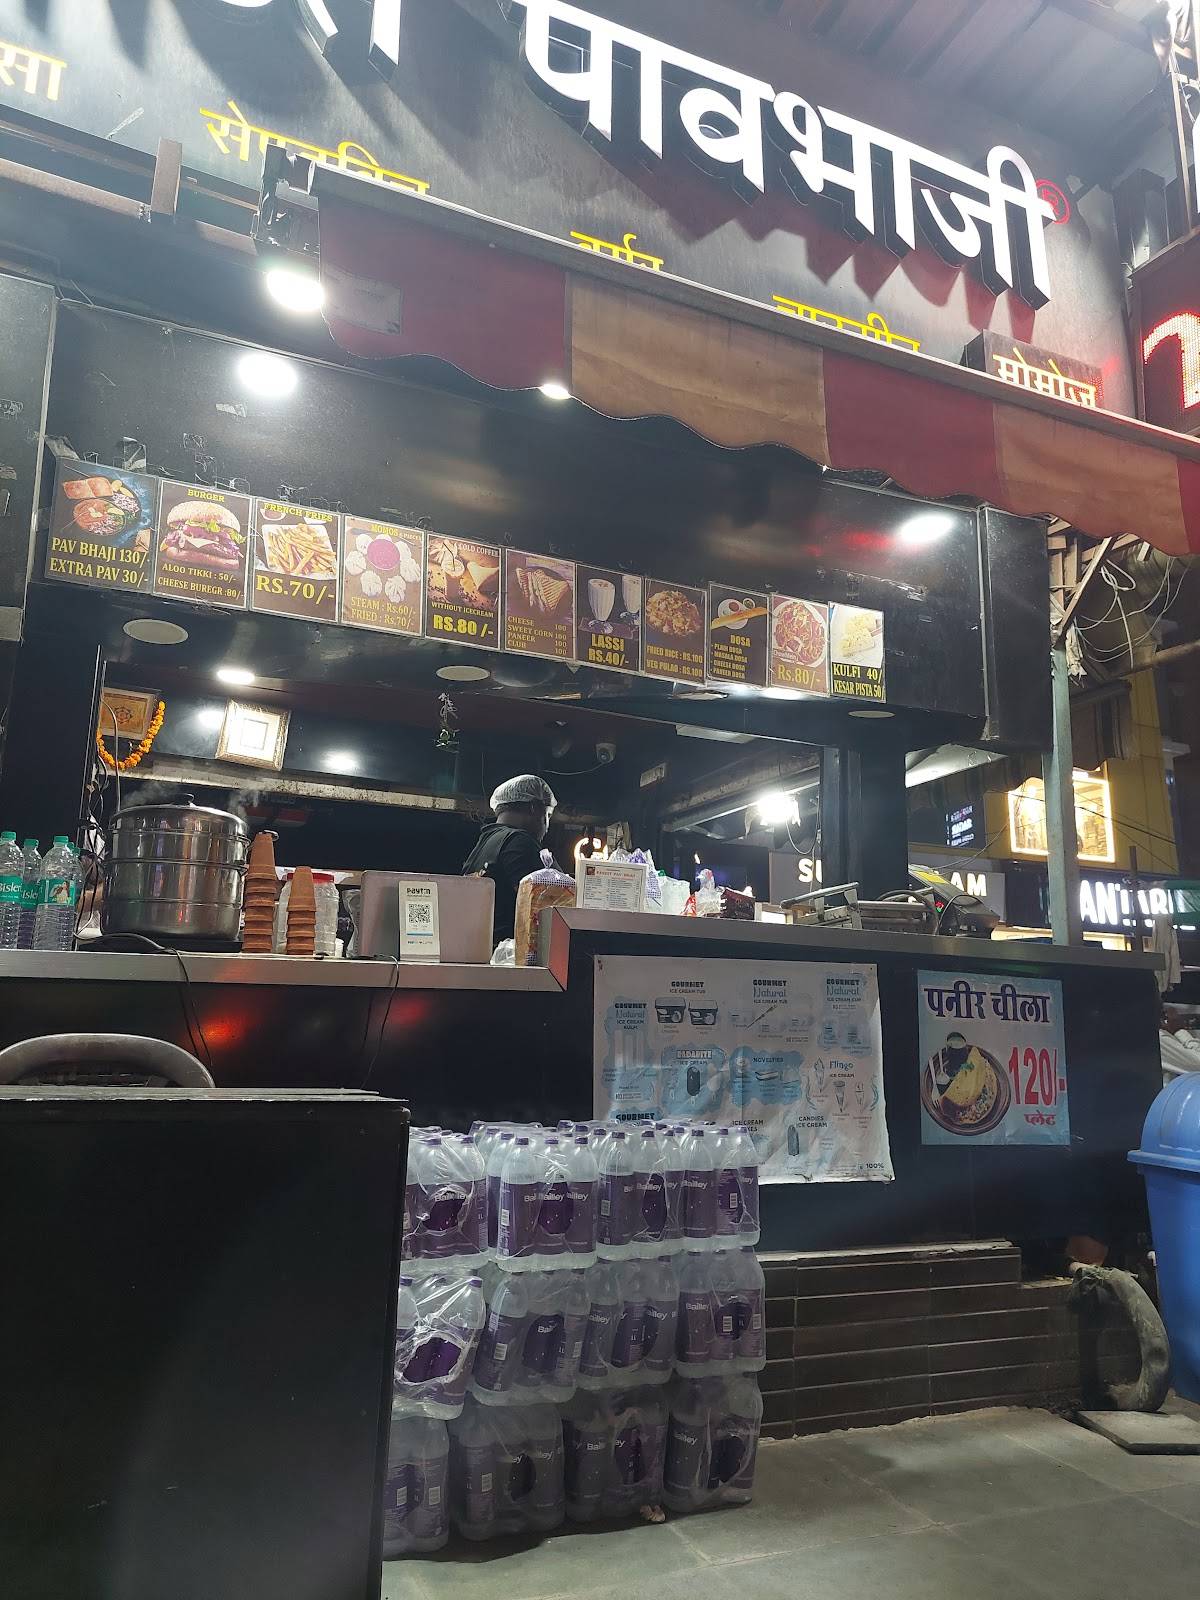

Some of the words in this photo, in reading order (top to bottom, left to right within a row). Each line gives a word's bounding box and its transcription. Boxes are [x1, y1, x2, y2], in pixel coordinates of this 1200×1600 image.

[510, 0, 1057, 301] पावभाजी
[187, 488, 225, 502] BURGER
[264, 502, 303, 517] FRENCH
[305, 512, 333, 522] FRIES
[51, 537, 76, 555] PAV
[79, 541, 117, 562] BHAJI
[50, 557, 93, 578] EXTRA
[96, 565, 120, 582] PAV
[122, 569, 148, 588] 30/-
[162, 563, 186, 575] ALOO
[187, 567, 212, 580] TIKKI
[158, 576, 189, 591] CHEESE
[190, 582, 223, 596] BUREGR
[256, 575, 335, 605] RS.70/-
[351, 596, 380, 610] STEAM
[431, 601, 461, 612] WITHOUT
[463, 607, 494, 618] ICECREAM
[351, 608, 377, 622] FRIED
[508, 615, 534, 626] CHEESE
[508, 624, 533, 636] SWEET
[534, 629, 553, 639] CORN
[591, 633, 625, 652] LASSI
[730, 634, 751, 648] DOSA
[833, 663, 861, 679] KULFI
[834, 679, 855, 695] KESAR
[855, 682, 873, 697] PISTA
[752, 979, 787, 987] GOURMET
[826, 978, 860, 986] GOURMET
[753, 986, 786, 998] Natural
[826, 986, 859, 996] Natural
[923, 980, 986, 1019] पनीर
[990, 983, 1050, 1023] चीला
[829, 1060, 854, 1071] Flingo
[1008, 1046, 1066, 1107] 120/-
[615, 1112, 655, 1122] GOURMET
[1023, 1109, 1056, 1126] प्लेट
